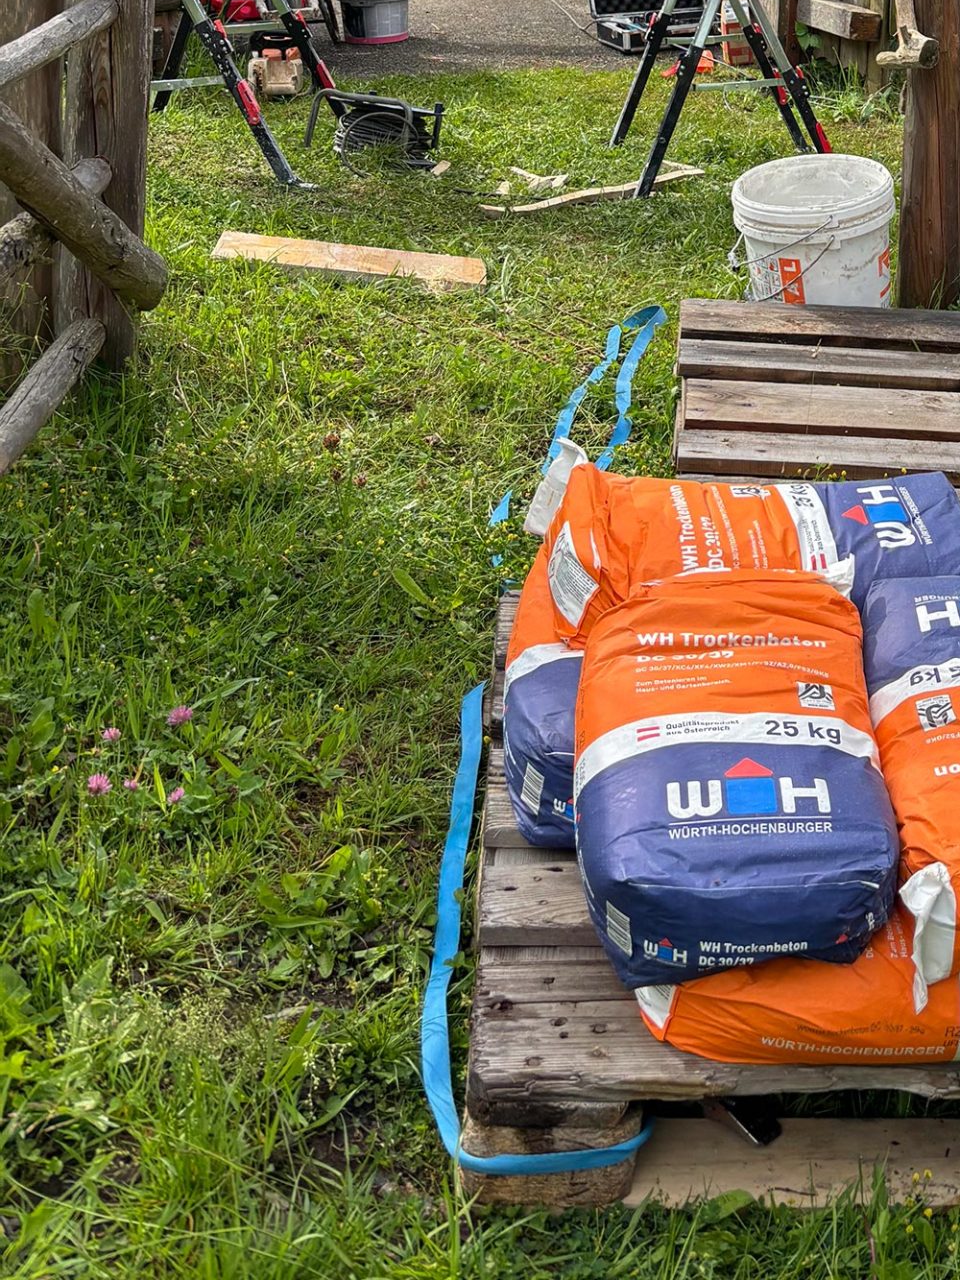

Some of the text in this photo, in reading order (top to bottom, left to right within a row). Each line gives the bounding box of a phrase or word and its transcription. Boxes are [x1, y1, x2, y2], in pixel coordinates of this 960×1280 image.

[636, 632, 827, 648] WH Trockenbeton
[909, 667, 941, 687] kg
[765, 719, 841, 745] 25 kg
[666, 776, 832, 819] WH
[668, 822, 834, 840] WÜRTH-HOCHENBURGER
[643, 939, 688, 964] WH
[700, 940, 809, 955] WH Trockenbeton
[698, 956, 716, 966] DC
[719, 956, 755, 967] 30/37
[761, 1035, 946, 1057] WÜRTH-HOCHENBURGER
